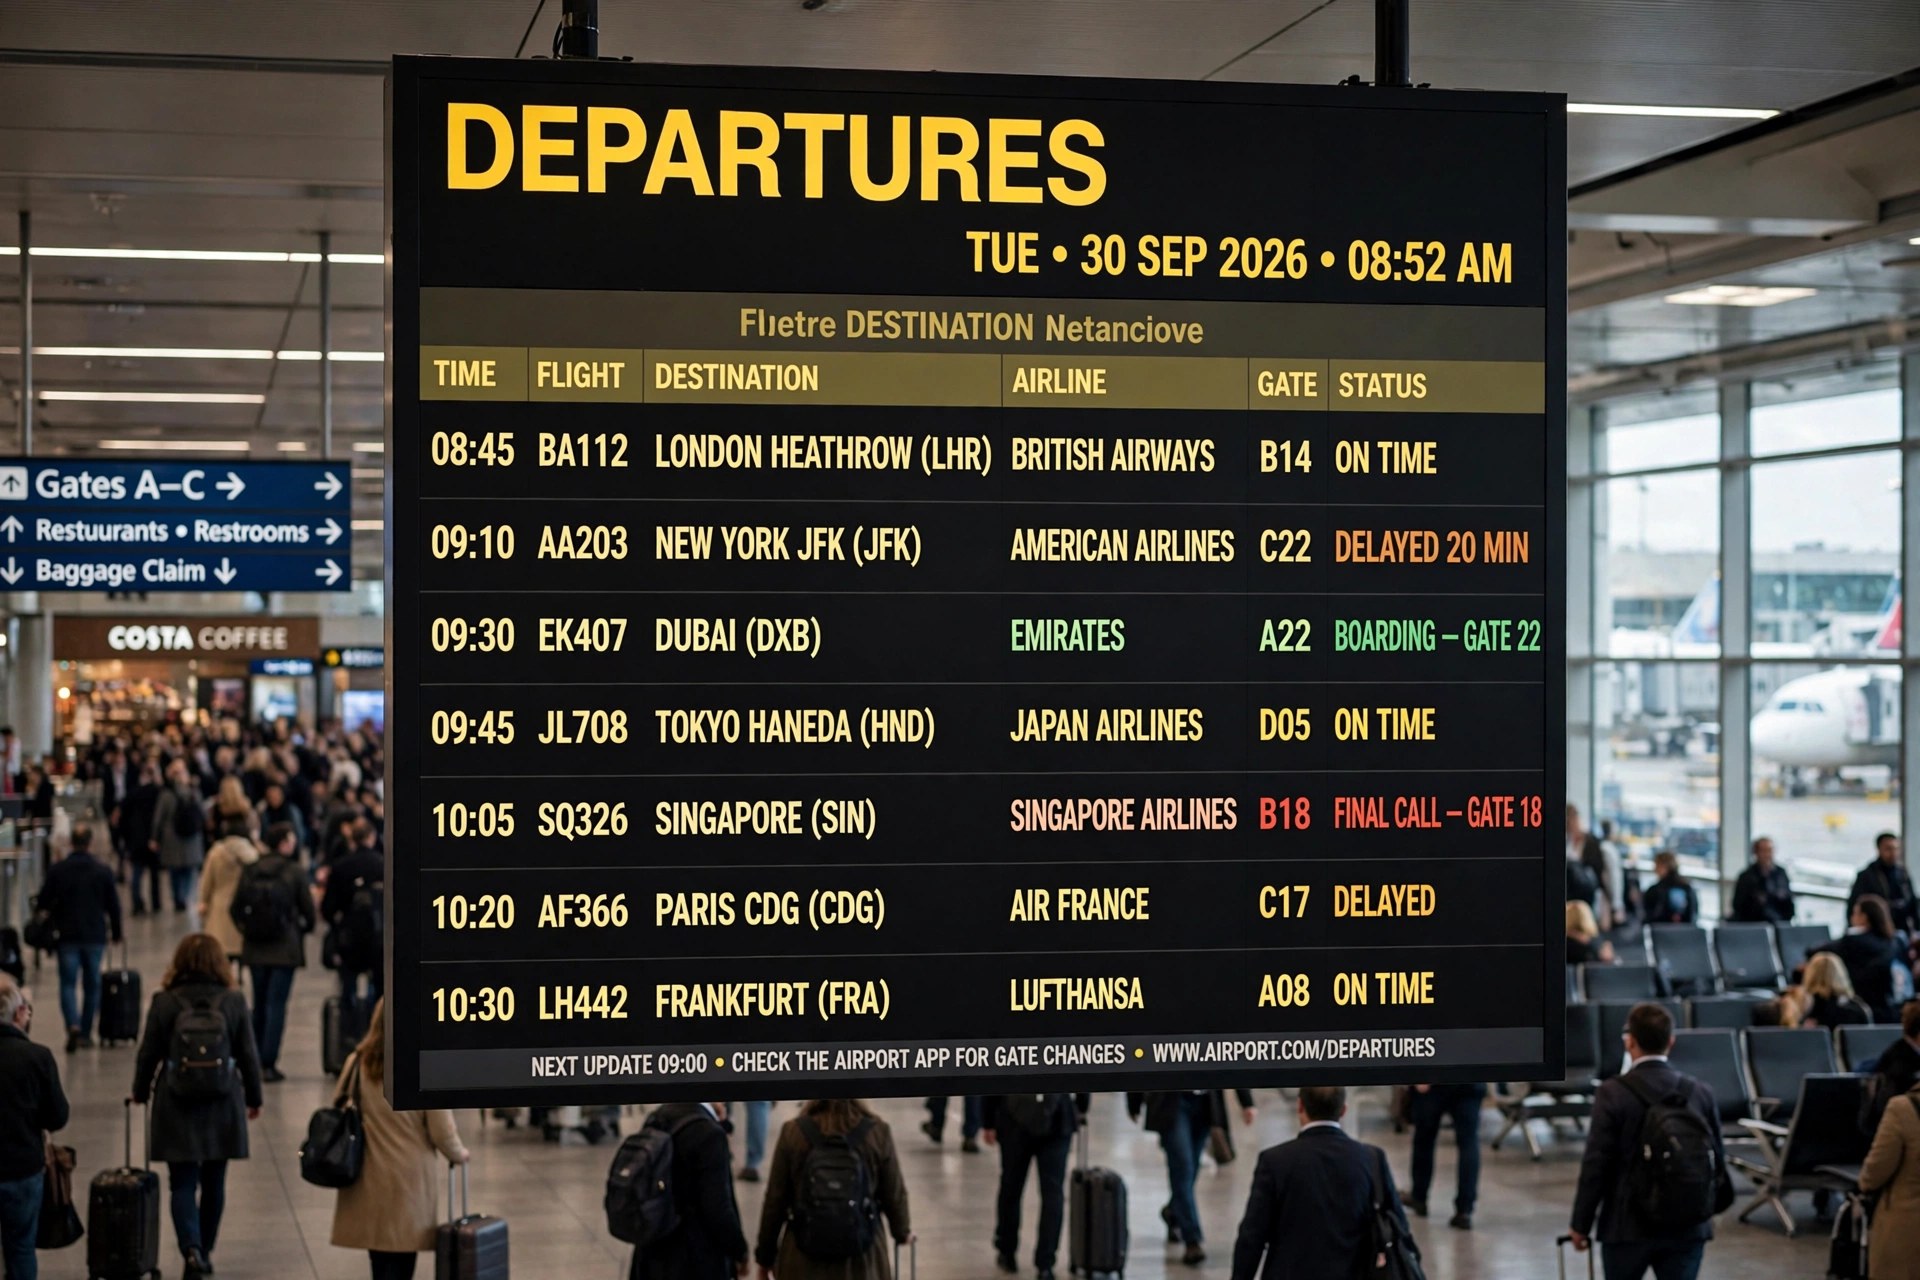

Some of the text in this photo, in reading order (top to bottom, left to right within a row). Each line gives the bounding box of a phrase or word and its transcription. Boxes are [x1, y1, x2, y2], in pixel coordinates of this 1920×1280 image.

[448, 103, 1106, 206] DEPARTURES
[966, 231, 1511, 283] TUE 30 SEP 2026 08:52 AM
[847, 310, 1033, 340] DESTINATION
[1046, 314, 1203, 343] Netanciove
[434, 360, 496, 386] TIME
[538, 362, 624, 388] FLIGHT
[656, 363, 818, 390] DESTINATION
[1013, 368, 1106, 393] AIRLINE
[1258, 371, 1317, 396] GATE
[1339, 372, 1426, 398] STATUS
[432, 432, 514, 466] 08:45
[539, 433, 627, 466] BA112
[656, 434, 991, 476] LONDON HEATHROW (LHR)
[1013, 438, 1214, 472] BRITISH AIRWAYS
[1261, 440, 1311, 472] B14
[1336, 441, 1436, 473] ON TIME
[36, 469, 126, 499] Gates
[195, 520, 309, 542] Restrooms
[432, 525, 514, 559] 09:10
[538, 526, 627, 559] AA203
[656, 526, 921, 567] NEW YORK JFK (JFK)
[1011, 529, 1234, 561] AMERICAN AIRLINES
[1261, 529, 1311, 562] C22
[1336, 530, 1528, 563] DELAYED 20 MIN
[37, 558, 205, 587] Baggage Claim
[109, 626, 286, 650] COSTA COFFEE
[432, 618, 514, 652] 09:30
[540, 618, 627, 651] EK407
[656, 617, 820, 658] DUBAI (DXB)
[1012, 619, 1124, 651] EMIRATES
[1260, 619, 1310, 651] A22
[1336, 620, 1435, 651] BOARDING
[1464, 620, 1511, 651] GATE
[1518, 620, 1540, 651] 22
[432, 711, 514, 744] 09:45
[539, 710, 627, 743] JL708
[656, 707, 934, 748] TOKYO HANEDA (HND)
[1011, 709, 1202, 741] JAPAN AIRLINES
[1261, 708, 1310, 740] D05
[1335, 708, 1435, 740] ON TIME
[433, 803, 514, 837] 10:05
[538, 802, 628, 841] SQ326
[656, 798, 875, 840] SINGAPORE (SIN)
[1011, 798, 1237, 831] SINGAPORE AIRLINES
[1260, 797, 1310, 829] B18
[1335, 797, 1389, 828] FINAL
[1395, 797, 1441, 828] CALL
[1468, 796, 1514, 827] GATE
[1521, 796, 1541, 827] 18
[433, 895, 514, 929] 10:20
[538, 894, 628, 927] AF366
[657, 889, 884, 930] PARIS CDG (CDG)
[1010, 888, 1149, 921] AIR FRANCE
[1260, 886, 1309, 918] C17
[1335, 885, 1435, 917] DELAYED
[433, 987, 514, 1021] 10:30
[540, 985, 627, 1019] LH442
[657, 979, 889, 1021] FRANKFURT (FRA)
[1011, 977, 1144, 1010] LUFTHANSA
[1259, 974, 1309, 1007] A08
[1334, 972, 1434, 1005] ON TIME
[532, 1038, 1435, 1076] NEXT UPDATE 09:00 CHECK THE AIRPORT APP FOR GATE CHANGES WWW.AIRPORT.COM/DEPARTURES
